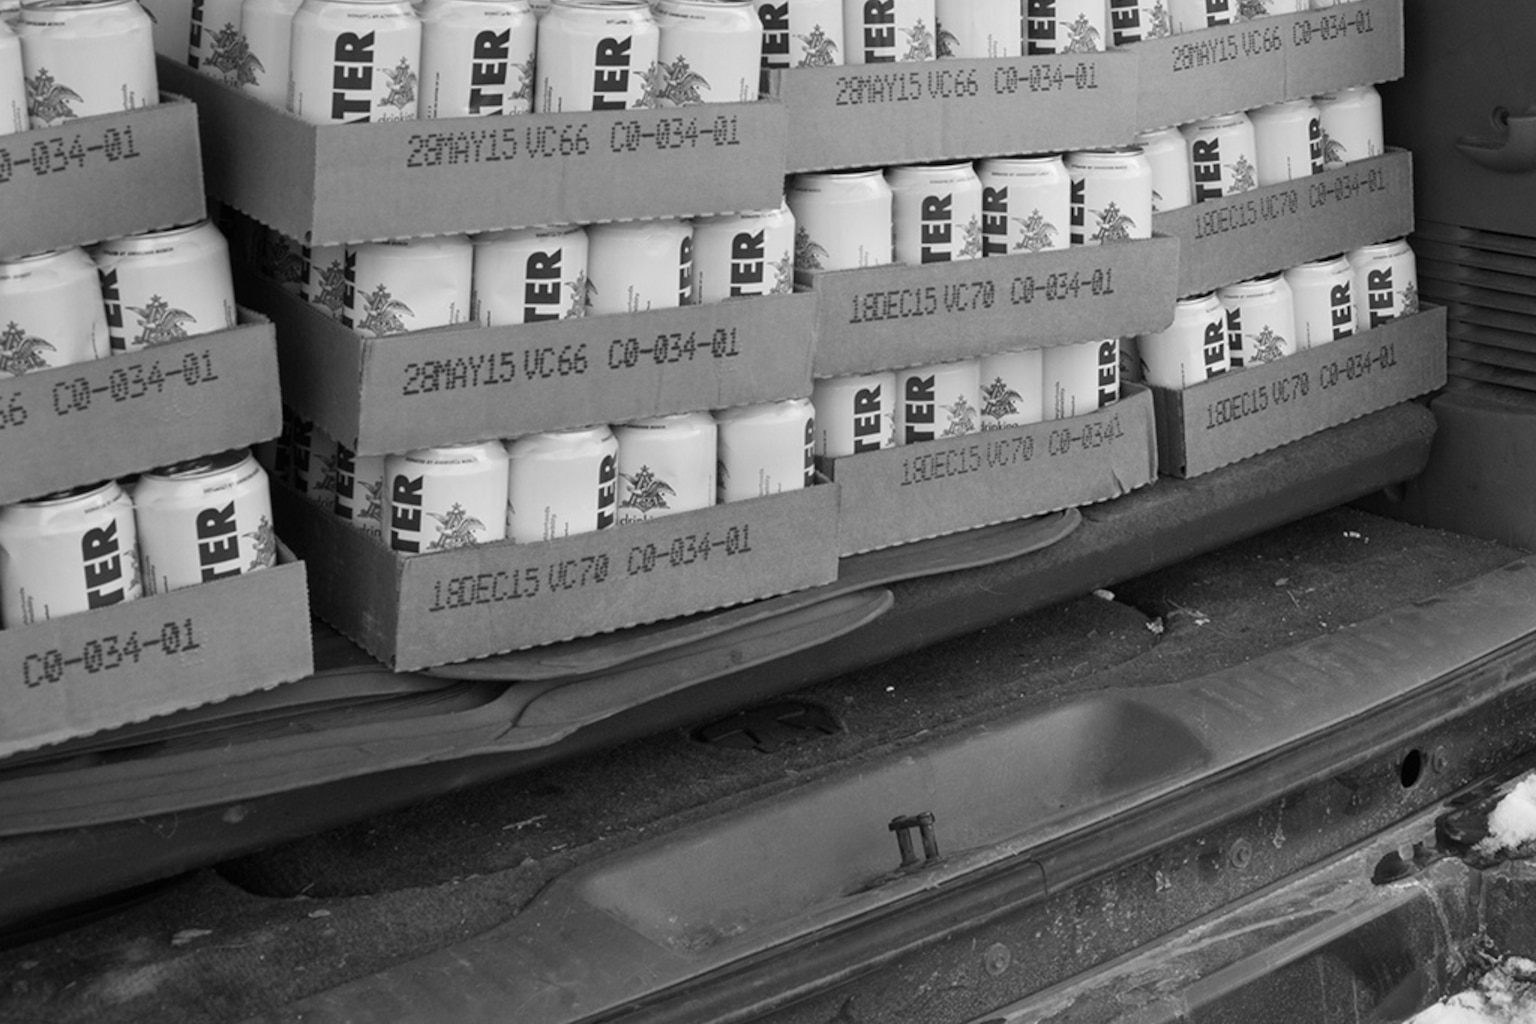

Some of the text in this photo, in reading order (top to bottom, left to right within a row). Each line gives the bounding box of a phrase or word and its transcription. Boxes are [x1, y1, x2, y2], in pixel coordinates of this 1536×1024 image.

[469, 28, 511, 116] TER
[592, 35, 632, 111] TER
[1172, 8, 1374, 72] 28MAY15 VC66 C0-034-01
[331, 30, 375, 124] TER
[836, 62, 1098, 106] 28MAY15 VC66 C0-034-01
[406, 115, 740, 167] 28MAY15 VC66 C0-034-01
[1192, 137, 1222, 204] TER
[921, 193, 952, 264] TER
[982, 186, 1008, 257] TER
[1195, 167, 1386, 240] 18DEC15 VC70 C0-034-01
[524, 248, 562, 323] TER
[849, 268, 1114, 324] 18DEC15 VC70 C0-034-01
[1330, 280, 1353, 341] TER
[1368, 266, 1393, 328] TER
[53, 349, 219, 416] C0-034-01
[402, 327, 740, 396] 28MAY15 VC66 C0-034-01
[1098, 339, 1119, 407] TER
[1204, 317, 1226, 380] TER
[854, 384, 881, 455] TER
[905, 374, 935, 445] TER
[1206, 343, 1397, 430] 18DEC15 VC70 C0-034-01
[986, 435, 1034, 469] VC70
[391, 474, 424, 554] TER
[81, 518, 125, 611] TER
[428, 524, 752, 612] 18DEC15 VC70 C0-034-01
[23, 617, 200, 688] C0-034-01
